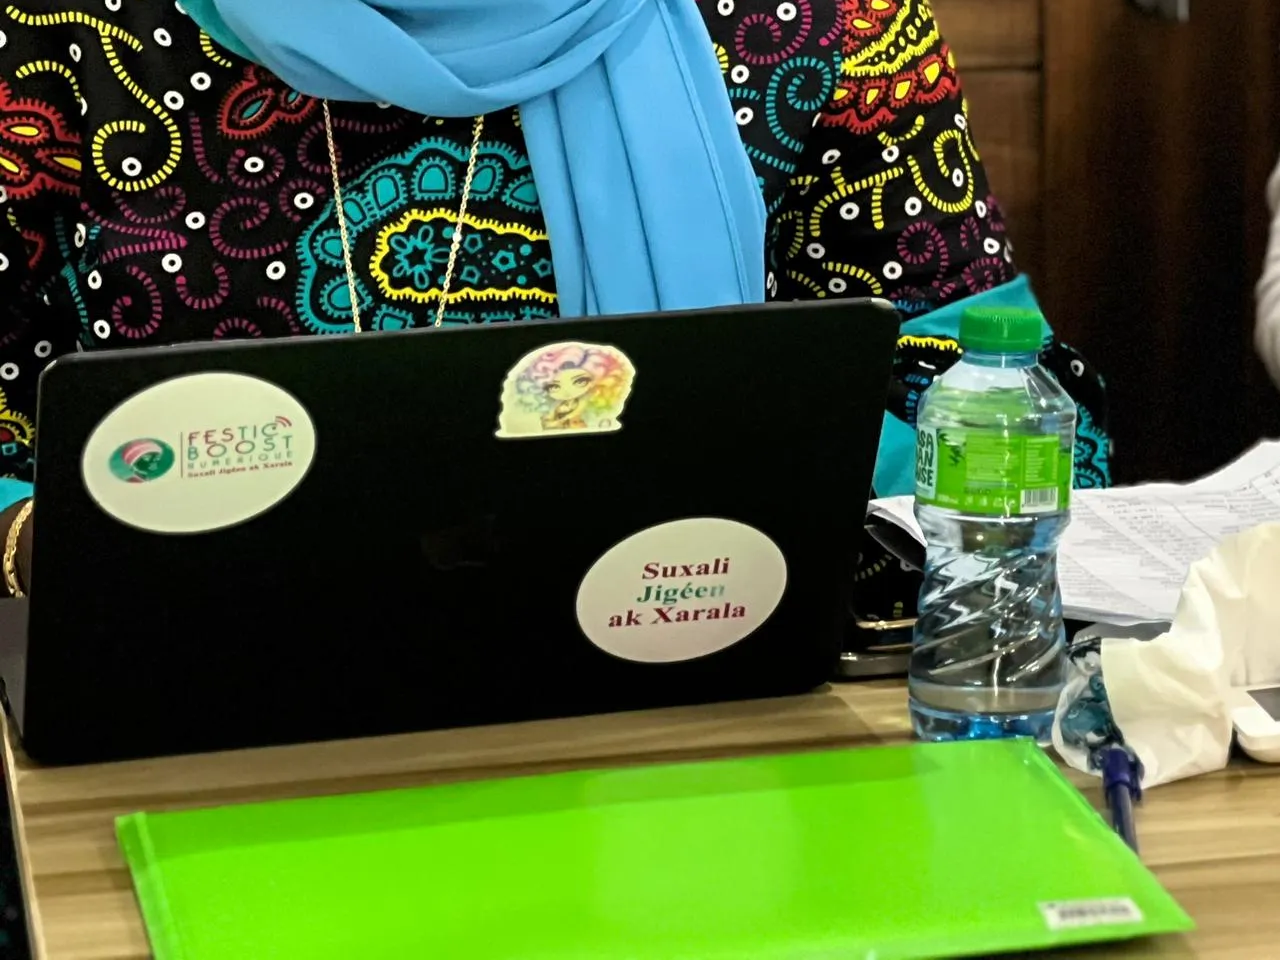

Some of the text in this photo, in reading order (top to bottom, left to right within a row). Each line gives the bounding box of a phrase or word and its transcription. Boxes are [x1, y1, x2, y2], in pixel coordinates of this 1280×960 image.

[188, 423, 280, 446] FESTIC
[188, 435, 293, 461] BOOST
[641, 557, 730, 580] Suxali
[636, 581, 725, 605] Jigéen
[608, 602, 747, 628] ak Xarala
